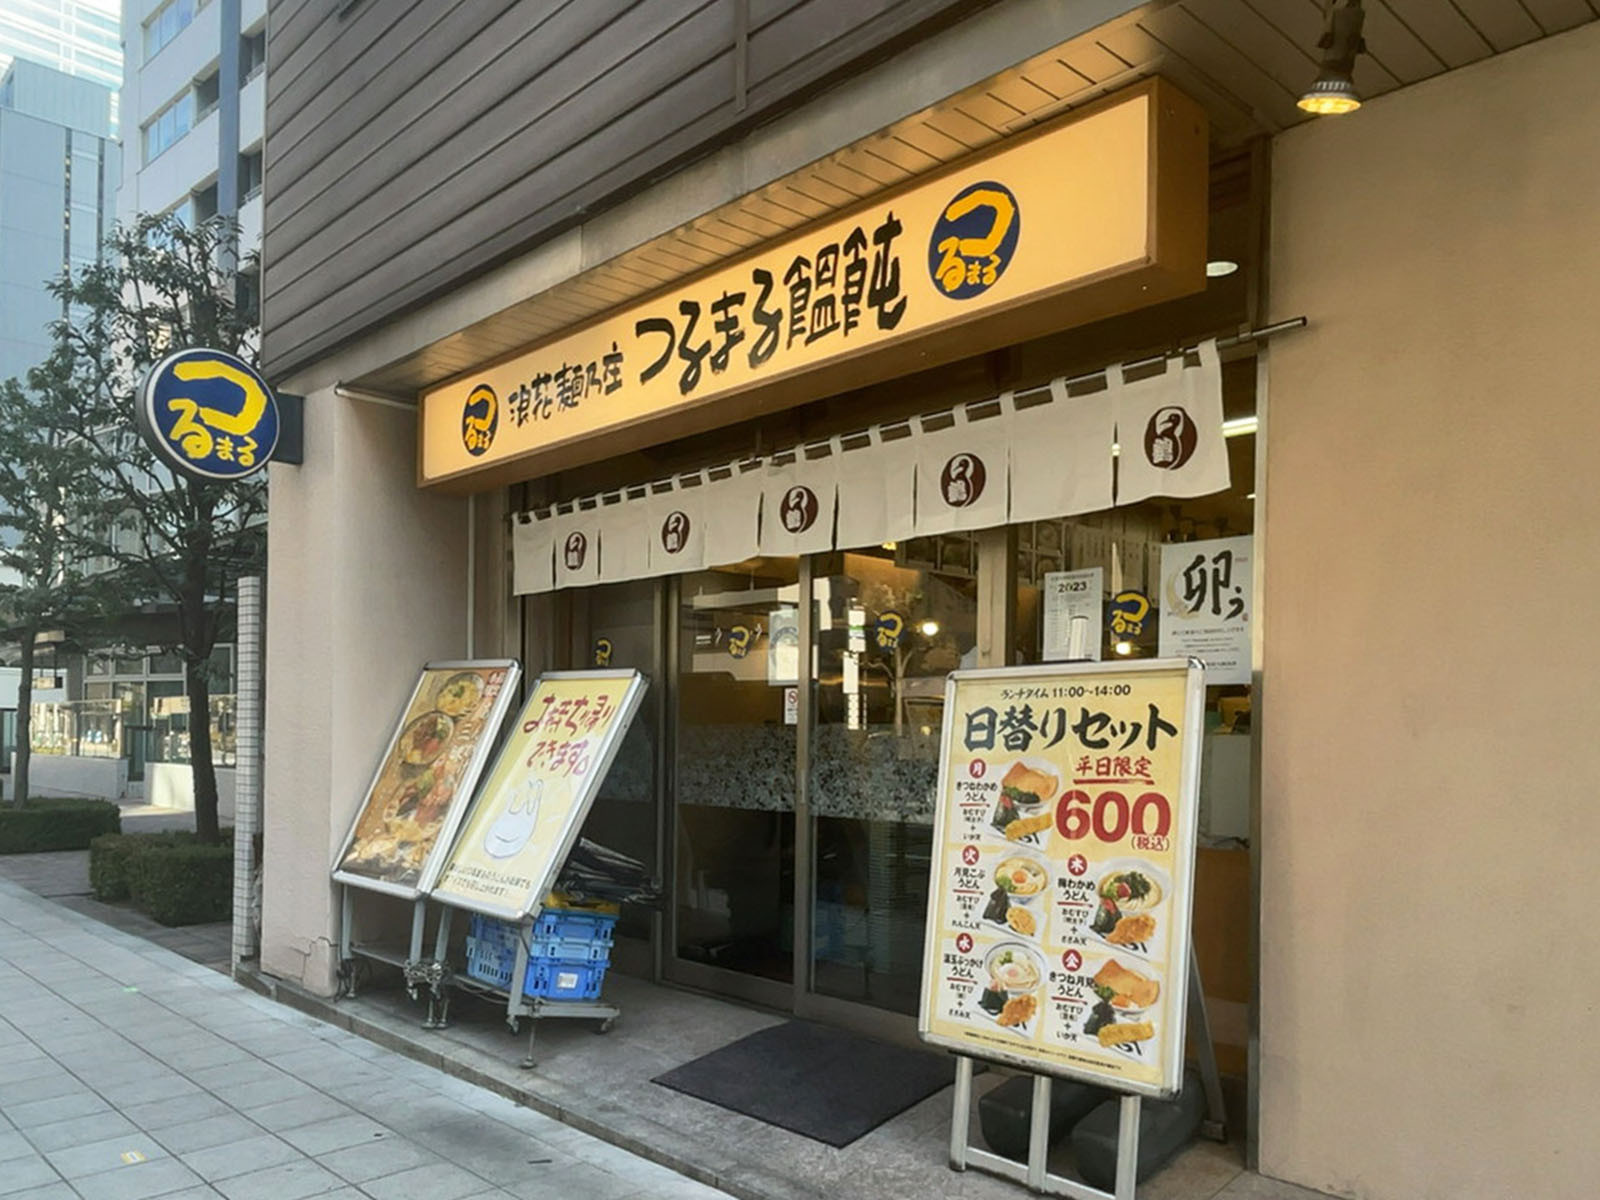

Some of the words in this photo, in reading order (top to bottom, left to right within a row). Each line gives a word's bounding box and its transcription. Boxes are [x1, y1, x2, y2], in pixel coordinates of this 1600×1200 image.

[936, 188, 1015, 292] つるまる
[168, 360, 268, 467] つるまる
[1058, 580, 1087, 593] 2023
[1001, 687, 1049, 700] ランチタイム
[964, 702, 1178, 752] 日替りセット
[1075, 755, 1153, 777] 平日限定
[965, 792, 987, 802] うどん
[1056, 789, 1171, 843] 600
[958, 878, 980, 890] うどん
[1063, 890, 1089, 902] うどん
[952, 966, 974, 978] うどん
[1049, 971, 1097, 989] きつね月見
[1058, 985, 1084, 998] うどん
